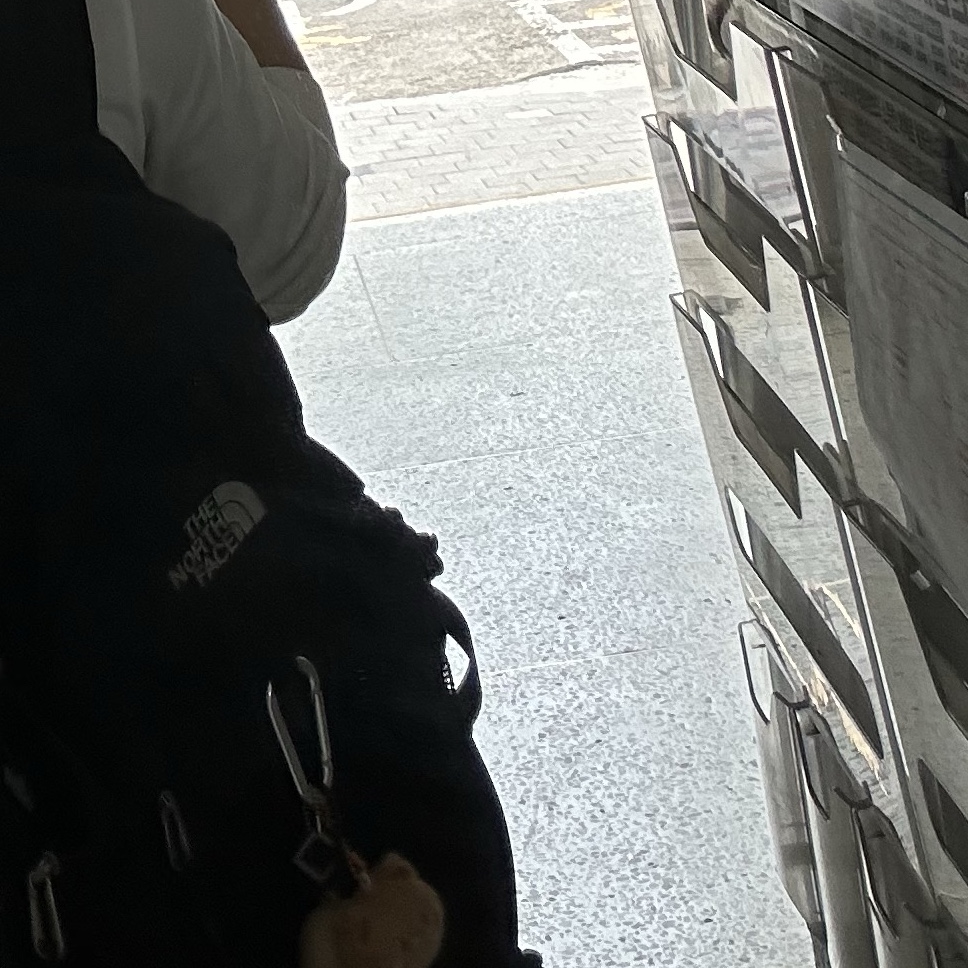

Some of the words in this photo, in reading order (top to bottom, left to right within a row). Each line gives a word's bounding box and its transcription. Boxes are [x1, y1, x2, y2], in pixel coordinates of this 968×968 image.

[183, 494, 219, 539] THE
[168, 513, 227, 590] NORTH
[196, 532, 238, 586] FACE
